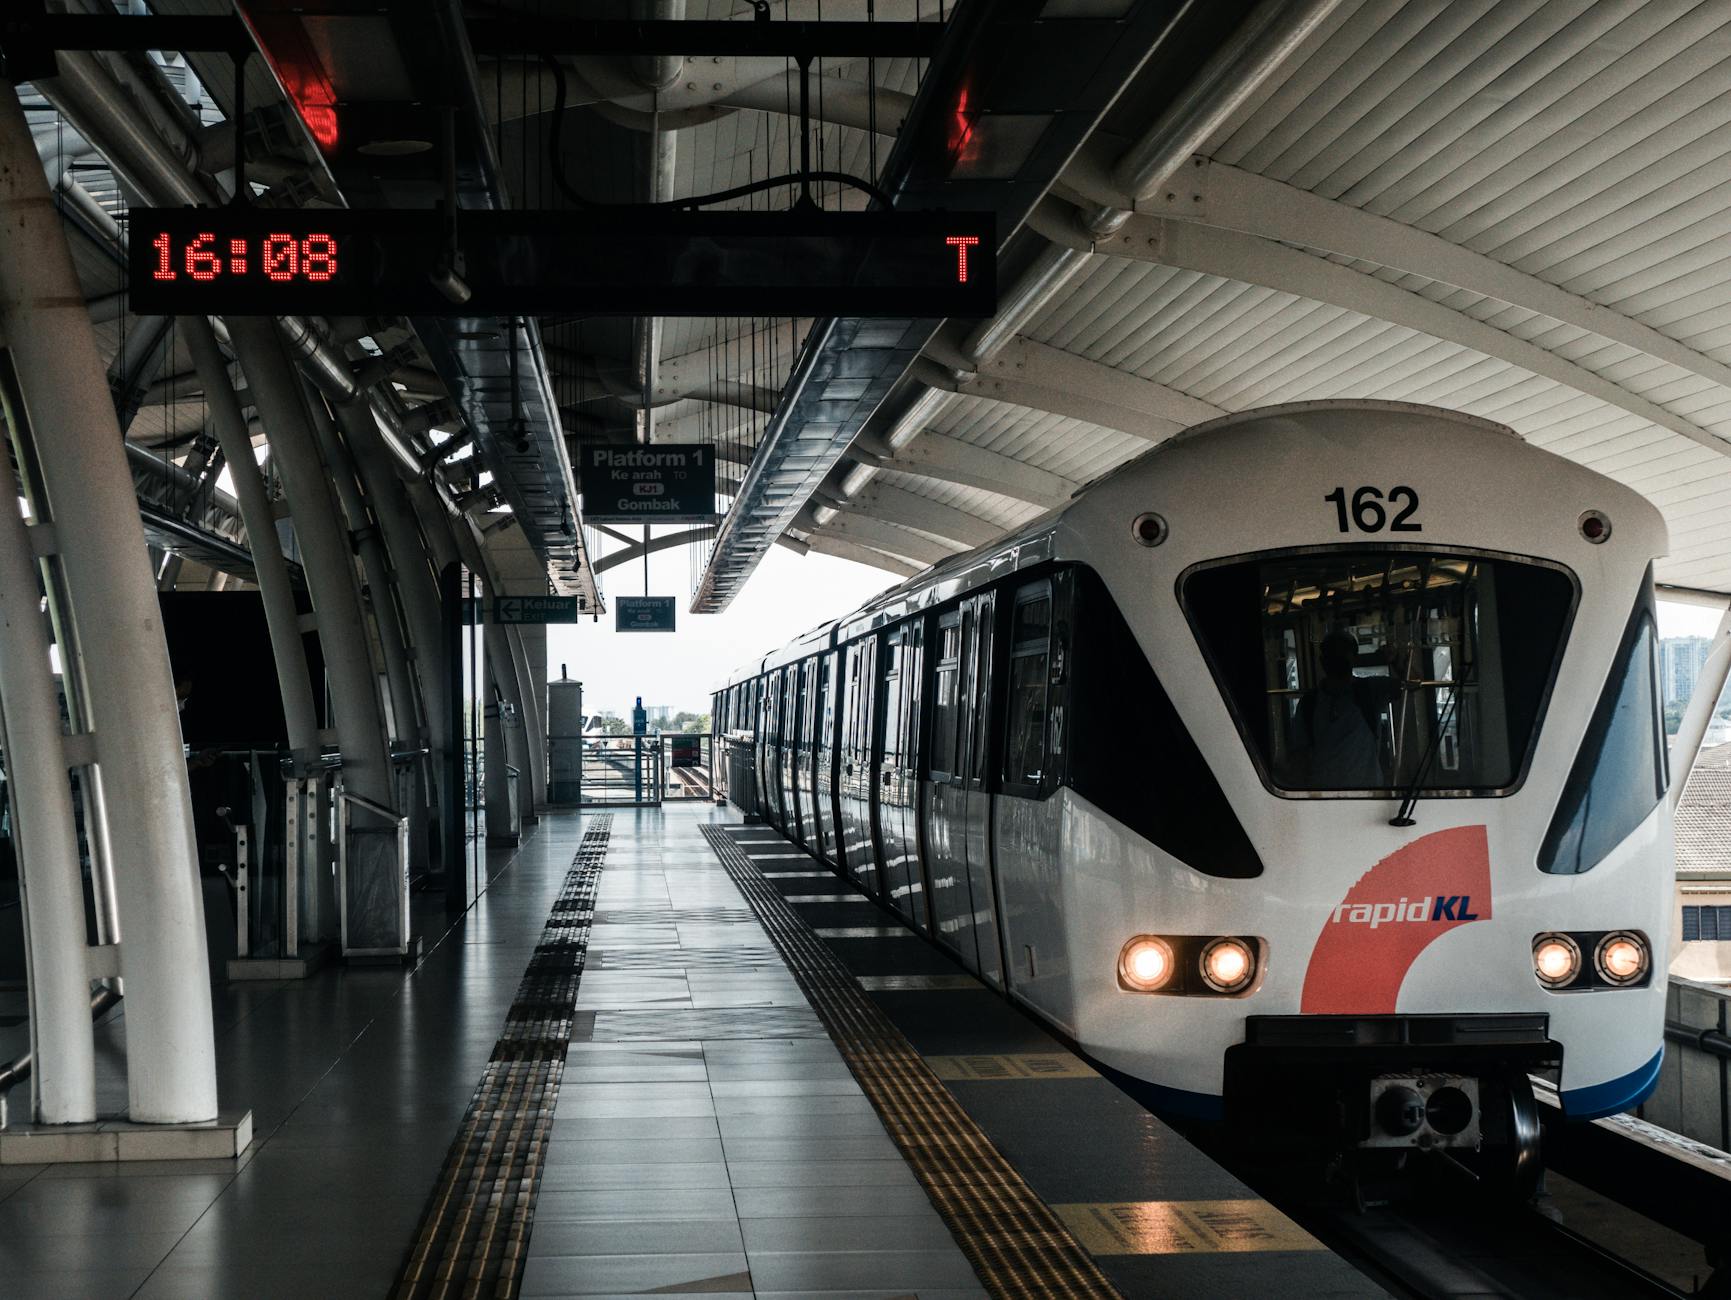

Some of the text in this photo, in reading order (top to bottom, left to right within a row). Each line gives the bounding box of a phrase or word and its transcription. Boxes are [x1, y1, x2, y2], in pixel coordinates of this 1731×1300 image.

[152, 233, 338, 282] 16:08
[946, 236, 979, 283] T
[593, 449, 703, 467] Platform 1
[611, 470, 629, 480] Ke
[632, 469, 662, 480] arah
[617, 498, 680, 511] Gombak
[1324, 485, 1422, 533] 162
[523, 598, 570, 610] Keluar
[619, 599, 670, 608] Platform 1
[1331, 894, 1479, 930] rapidKL
